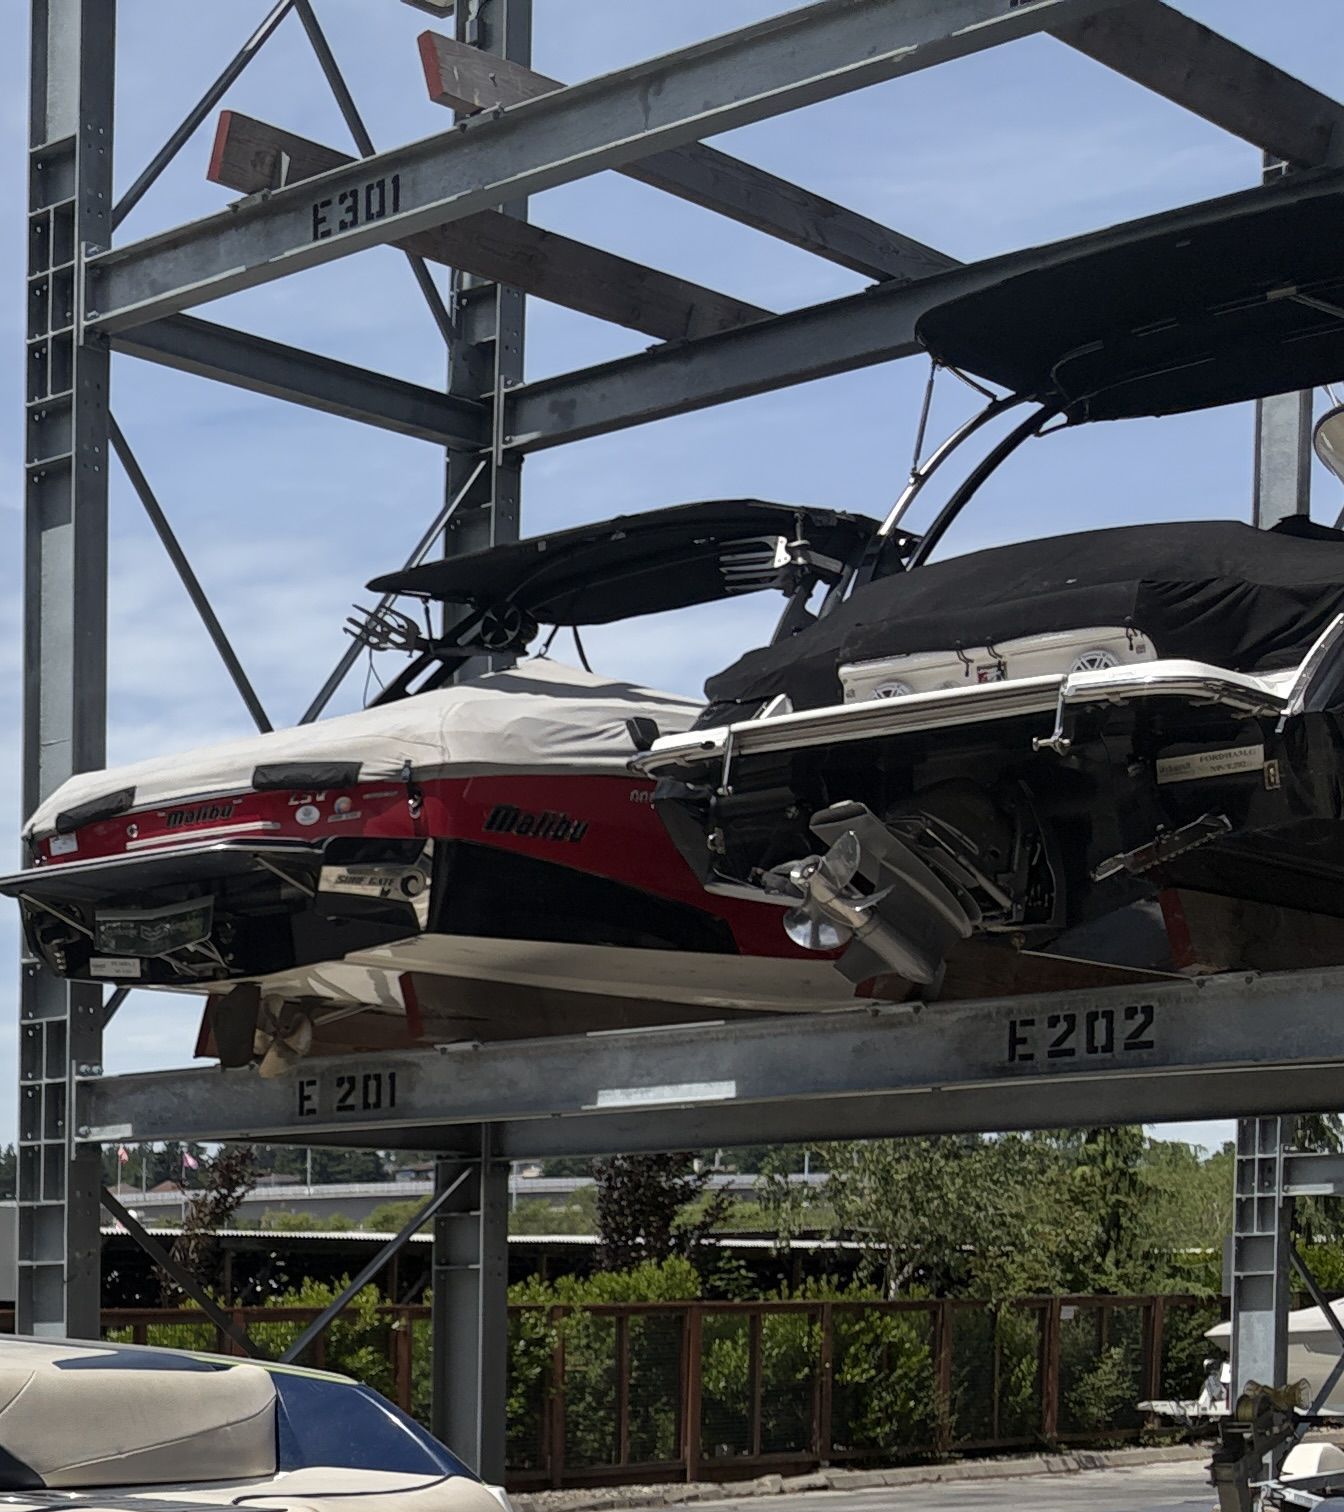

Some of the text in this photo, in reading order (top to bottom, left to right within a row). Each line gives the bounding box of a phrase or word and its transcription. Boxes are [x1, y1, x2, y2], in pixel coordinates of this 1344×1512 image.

[312, 174, 400, 241] E301
[166, 804, 233, 829] Malibu
[483, 804, 589, 843] Malibu
[1008, 1005, 1154, 1062] E202
